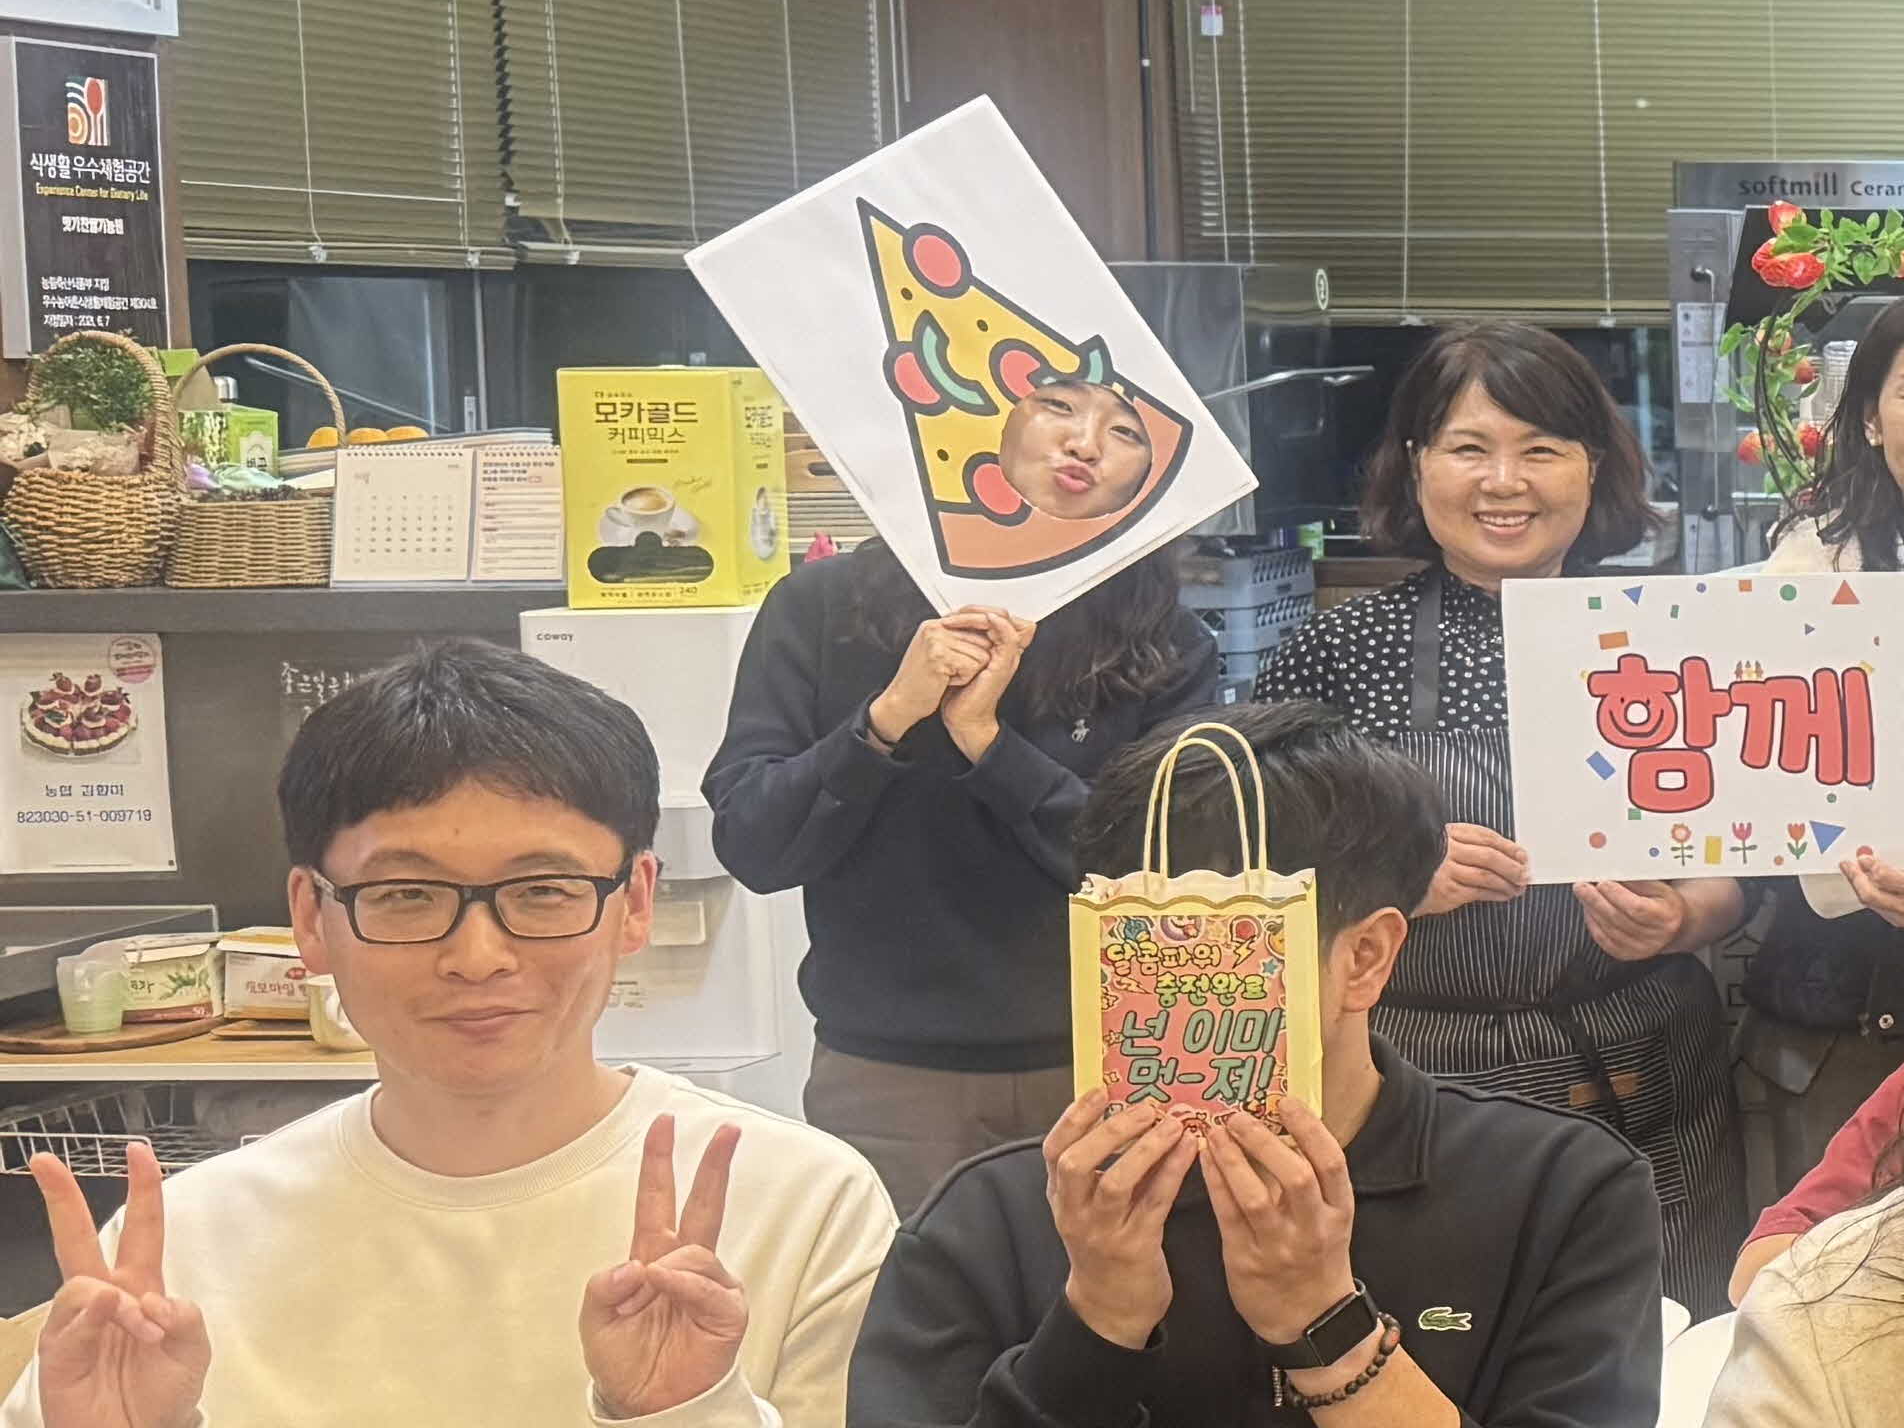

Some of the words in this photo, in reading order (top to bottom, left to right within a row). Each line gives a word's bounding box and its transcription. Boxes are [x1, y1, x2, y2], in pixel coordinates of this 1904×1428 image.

[30, 153, 71, 179] 식생활
[1738, 173, 1838, 197] softmill
[594, 402, 698, 423] 모카골드
[608, 427, 686, 444] 커피믹스
[1587, 652, 1874, 813] 함께
[1106, 942, 1222, 976] 달콤파워
[1155, 972, 1267, 1008] 충전완료
[1120, 1010, 1170, 1056] 넌
[1183, 1007, 1283, 1054] 이미
